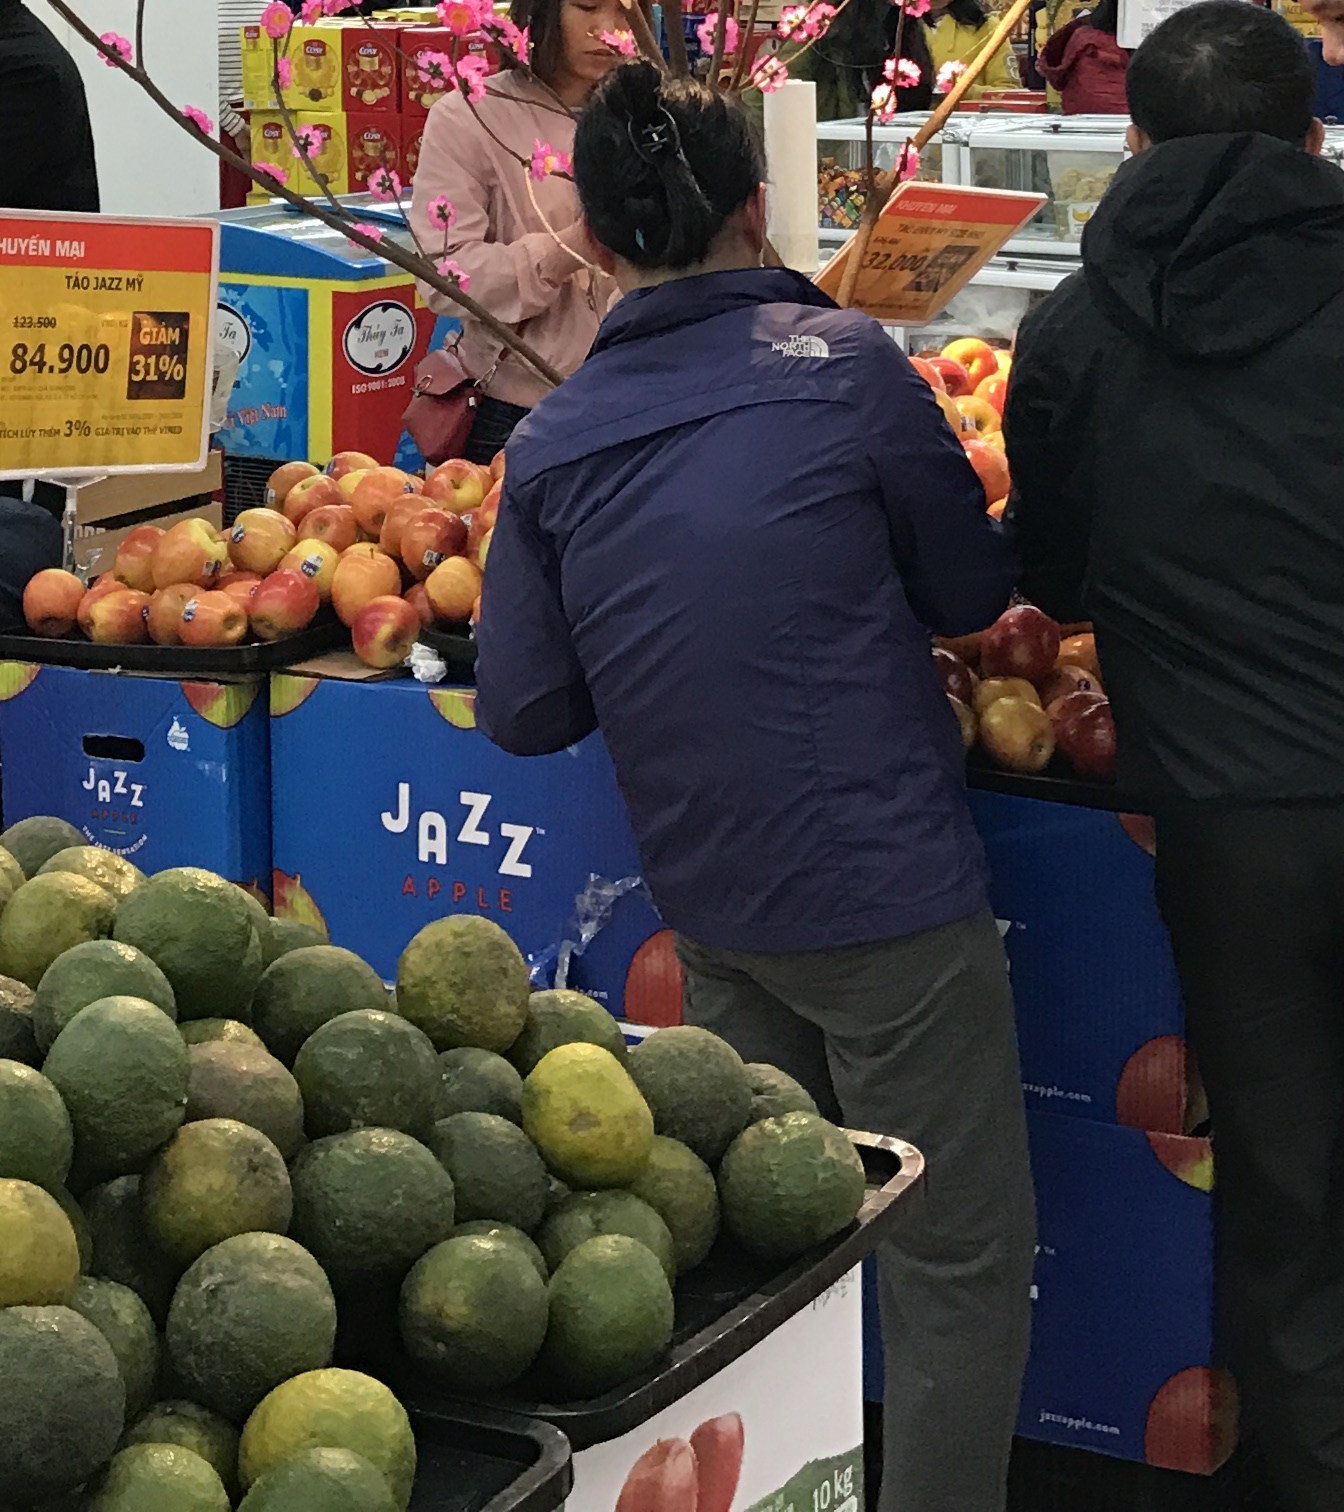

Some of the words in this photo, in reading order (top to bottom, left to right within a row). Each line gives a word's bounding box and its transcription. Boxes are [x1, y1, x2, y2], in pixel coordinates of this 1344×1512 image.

[56, 240, 85, 260] MẠI
[65, 271, 90, 291] TÁO
[93, 276, 122, 291] JAZZ
[125, 273, 144, 292] MỸ
[140, 321, 179, 345] GIẢM
[219, 322, 237, 345] Tạ
[389, 319, 404, 341] Tạ
[771, 342, 810, 351] NORTH
[782, 350, 810, 358] FACE
[9, 343, 110, 375] 84.900
[131, 355, 184, 382] 31%
[352, 384, 366, 394] ISO
[63, 420, 91, 438] 3%
[82, 768, 144, 807] JAZZ
[380, 782, 534, 878] JAZZ
[402, 874, 513, 912] APPLE
[1039, 1409, 1121, 1435] jazzapple.com
[813, 1480, 831, 1512] 10
[834, 1465, 853, 1499] kg
